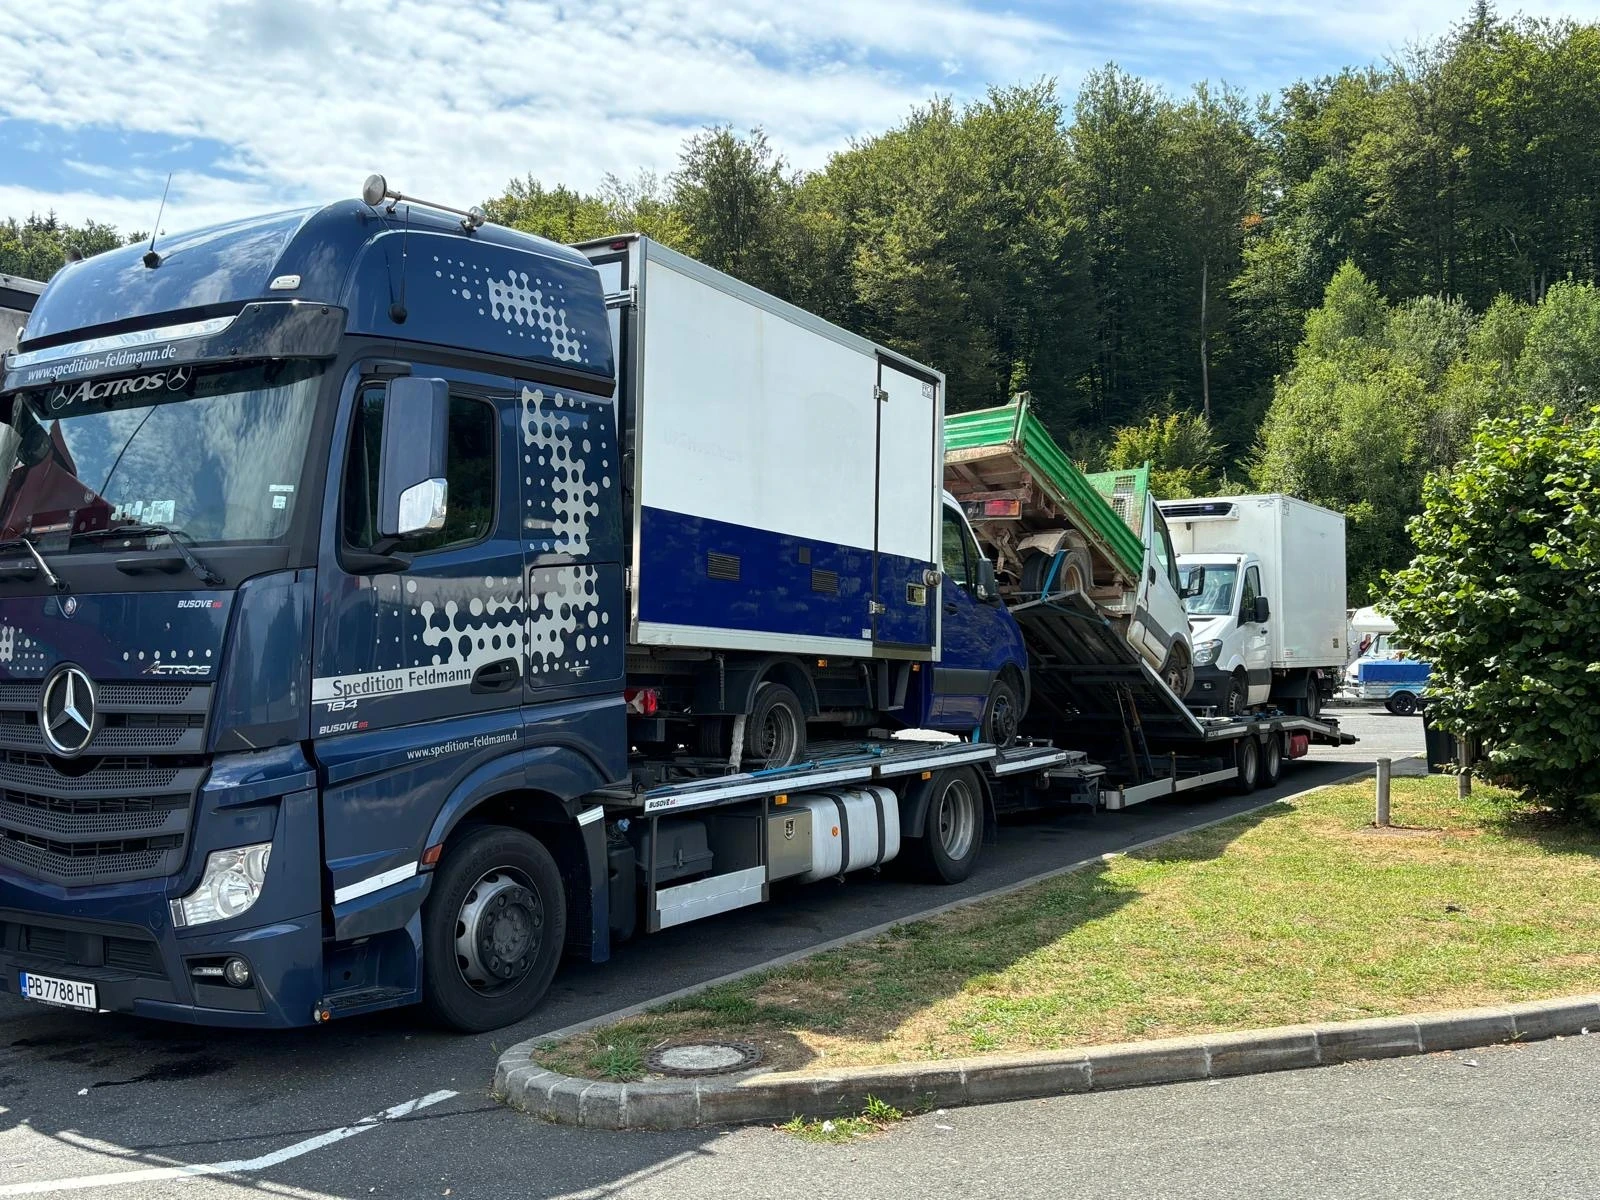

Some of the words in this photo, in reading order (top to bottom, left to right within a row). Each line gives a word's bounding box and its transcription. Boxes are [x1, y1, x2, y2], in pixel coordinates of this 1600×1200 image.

[27, 344, 177, 382] www.spedition-feldmann.de
[332, 675, 403, 699] Spedition
[408, 667, 471, 687] Feldmann
[327, 699, 358, 712] 184
